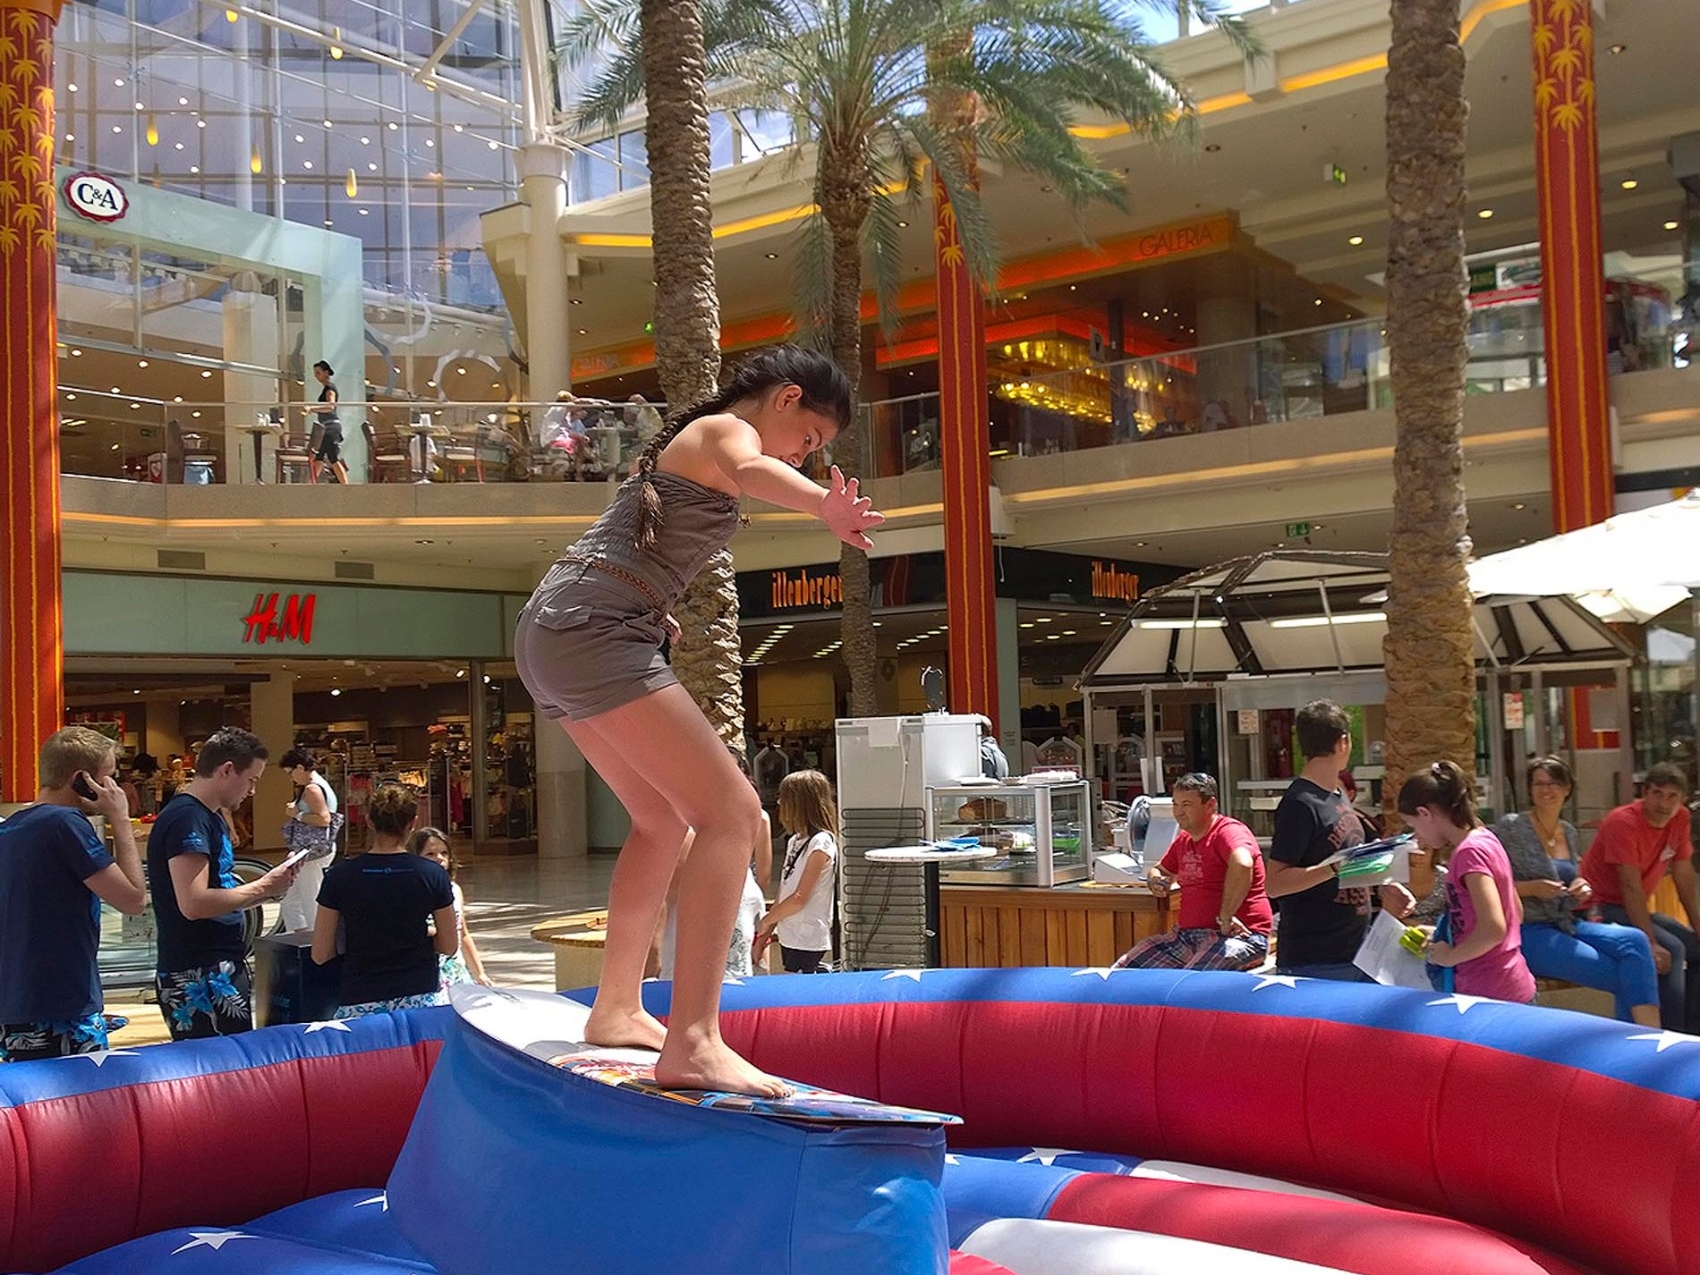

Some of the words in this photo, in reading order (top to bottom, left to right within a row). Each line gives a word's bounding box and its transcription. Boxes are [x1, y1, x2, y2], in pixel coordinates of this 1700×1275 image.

[77, 183, 119, 211] C&A
[1139, 223, 1213, 256] GALERIA
[244, 592, 316, 645] H&M
